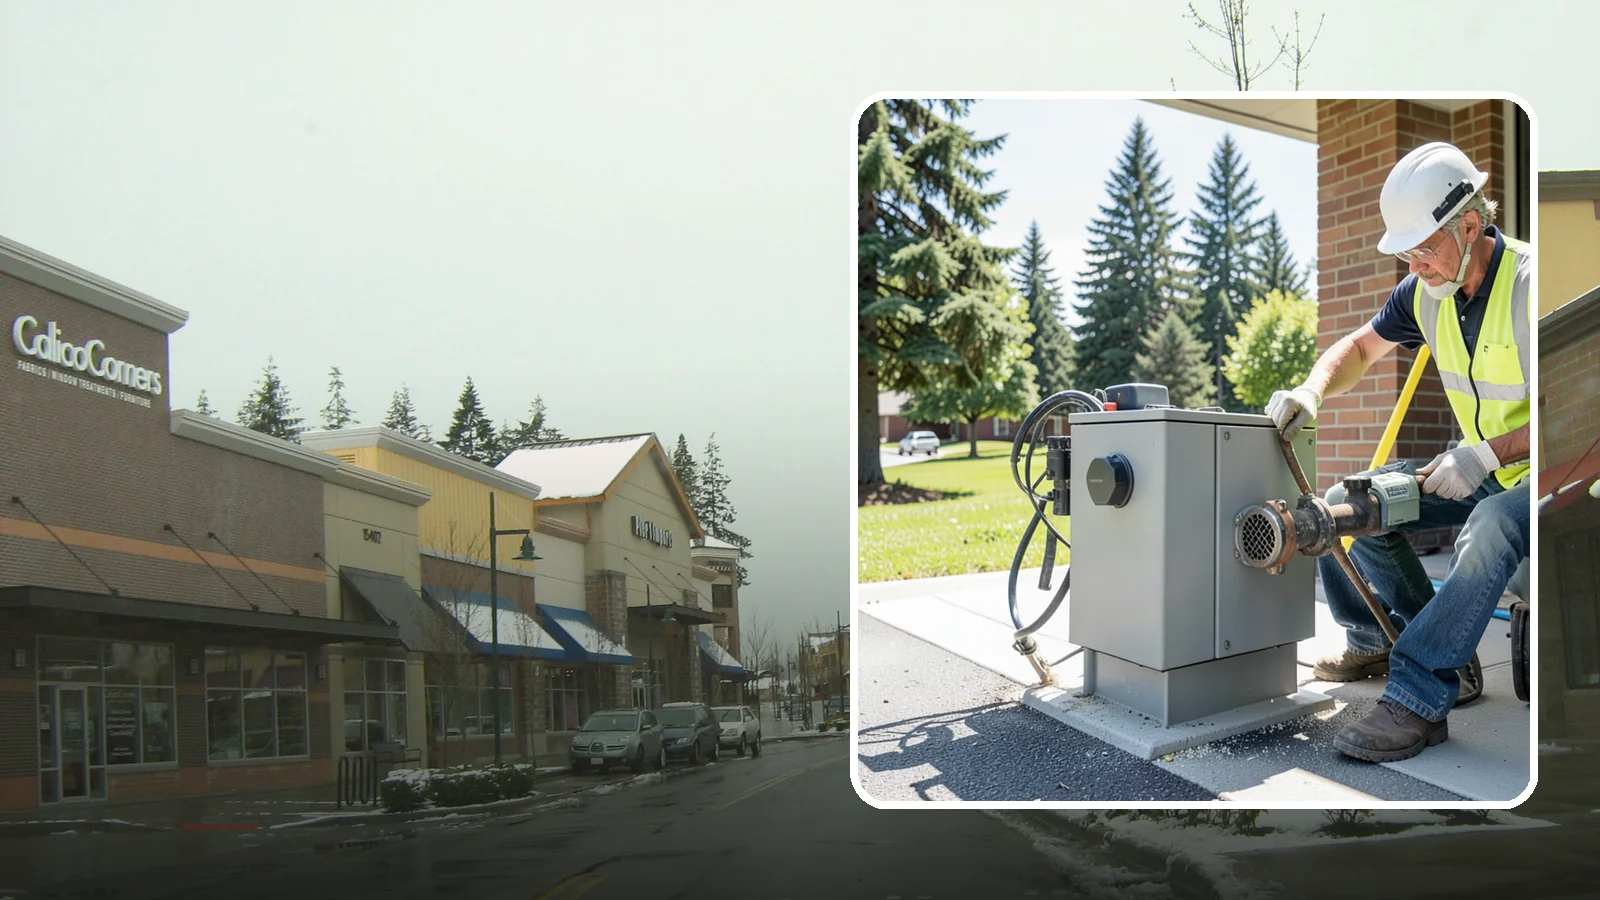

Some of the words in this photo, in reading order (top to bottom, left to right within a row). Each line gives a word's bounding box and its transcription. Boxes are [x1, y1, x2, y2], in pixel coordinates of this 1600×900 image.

[17, 359, 47, 378] FABRICS
[51, 370, 78, 386] WINDOW
[79, 378, 117, 398] TREATMENTS
[120, 390, 151, 409] FURNITURE
